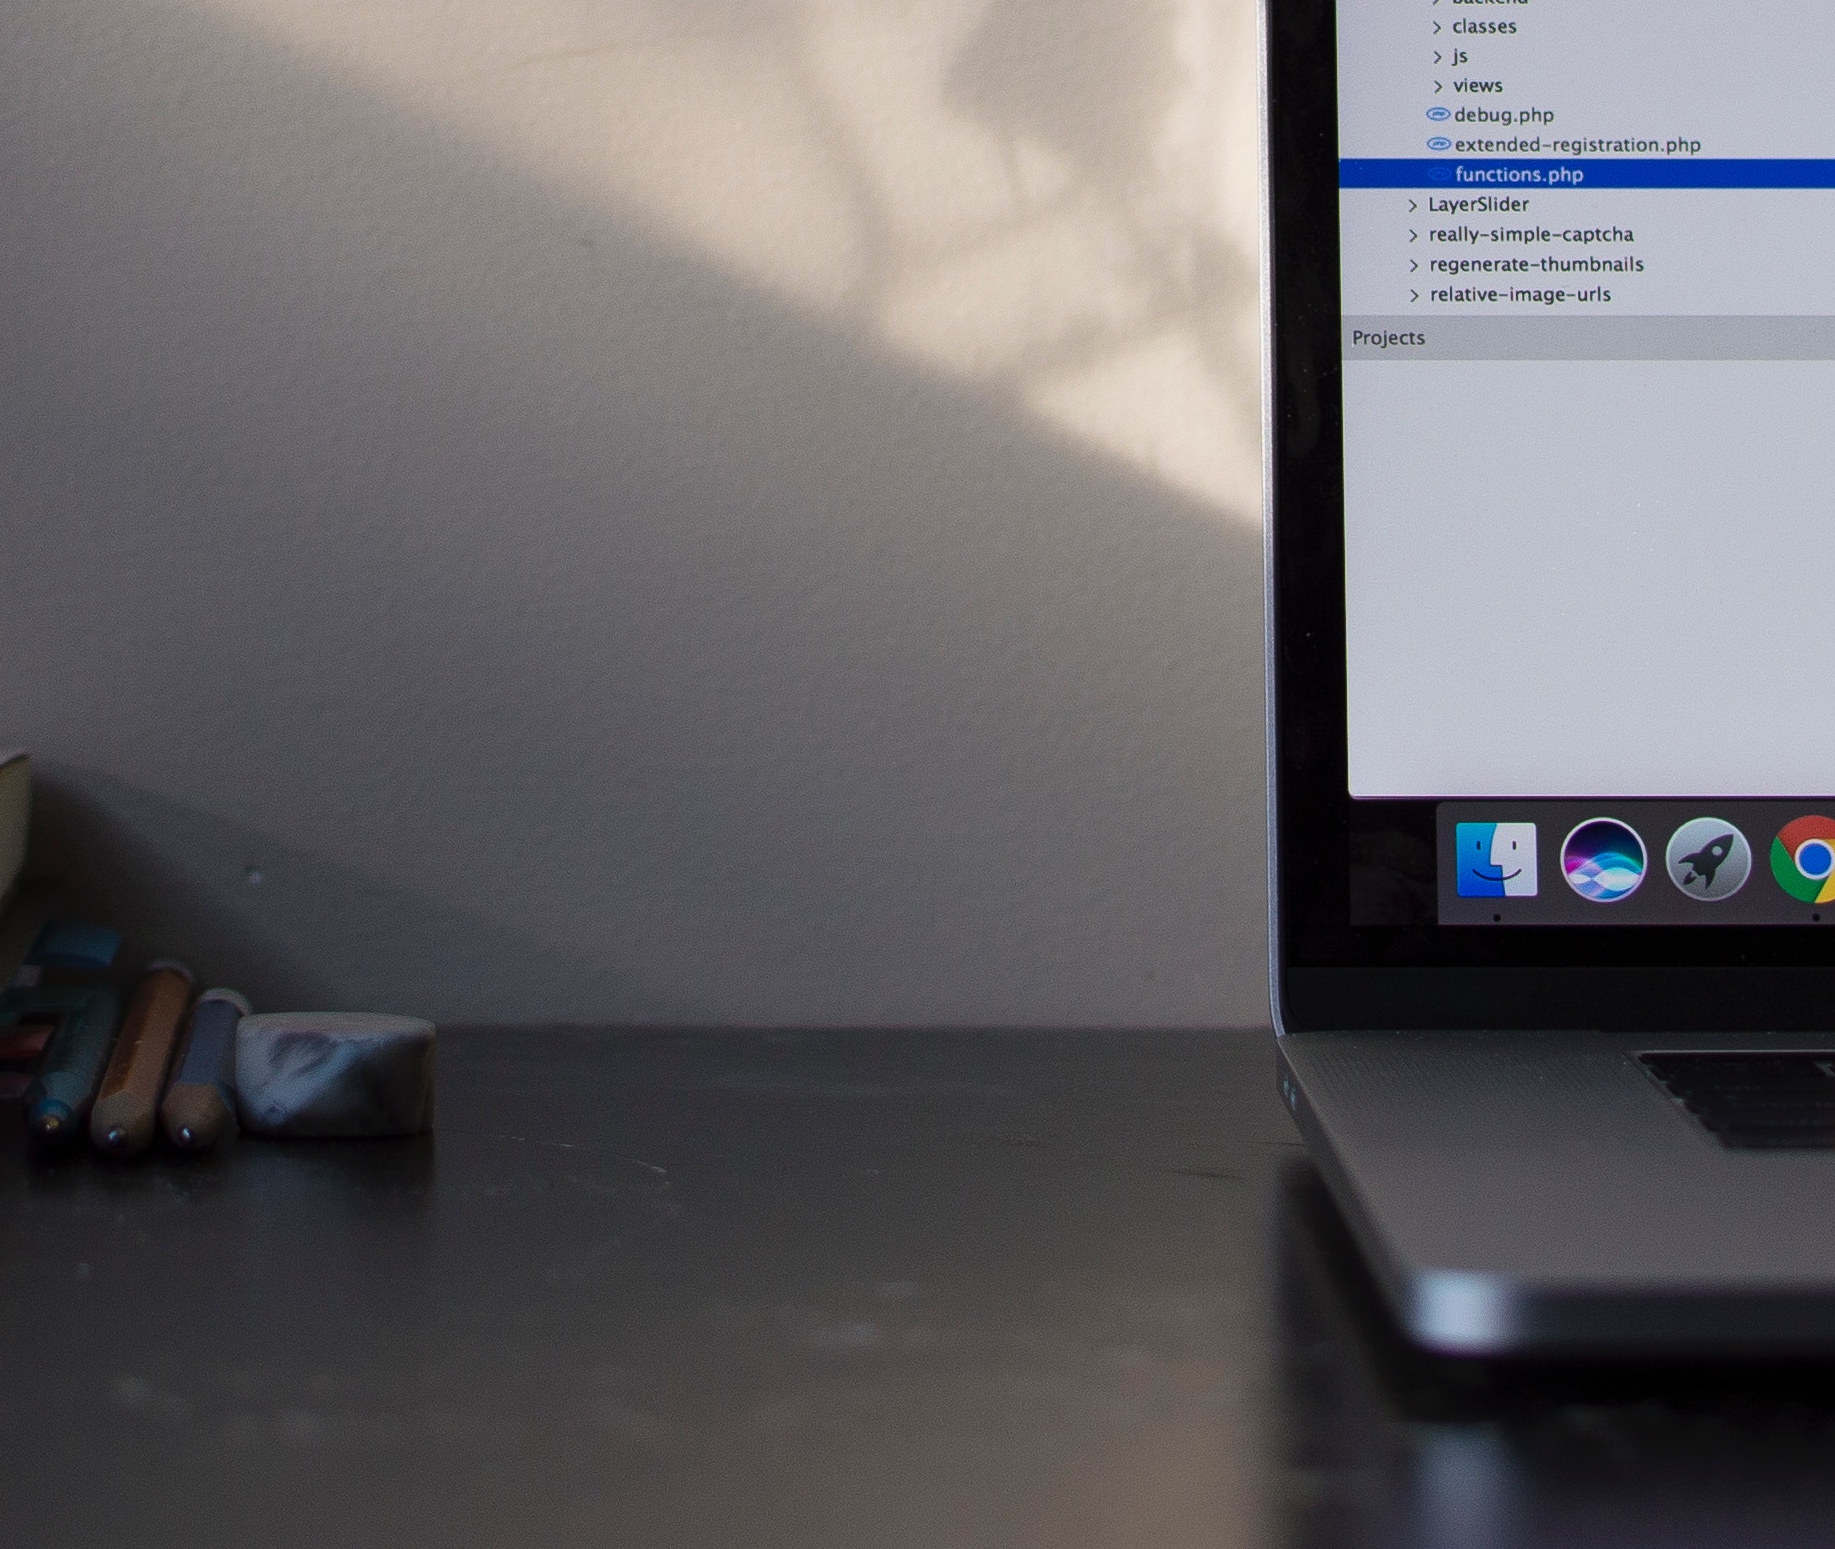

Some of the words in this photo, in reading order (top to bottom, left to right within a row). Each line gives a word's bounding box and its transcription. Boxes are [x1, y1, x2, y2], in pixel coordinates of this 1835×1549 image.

[1453, 19, 1517, 34] classes
[1452, 50, 1468, 66] js
[1454, 81, 1503, 93] views
[1455, 108, 1554, 126] debug.php
[1455, 137, 1701, 155] extended-registration.php
[1456, 166, 1584, 184] functions.php
[1430, 196, 1529, 214] LayerSlider
[1430, 227, 1634, 244] really-simple-captcha
[1431, 257, 1644, 275] regenerate-thumbnails
[1431, 287, 1611, 305] relative-image-urls
[1353, 330, 1425, 348] Projects
